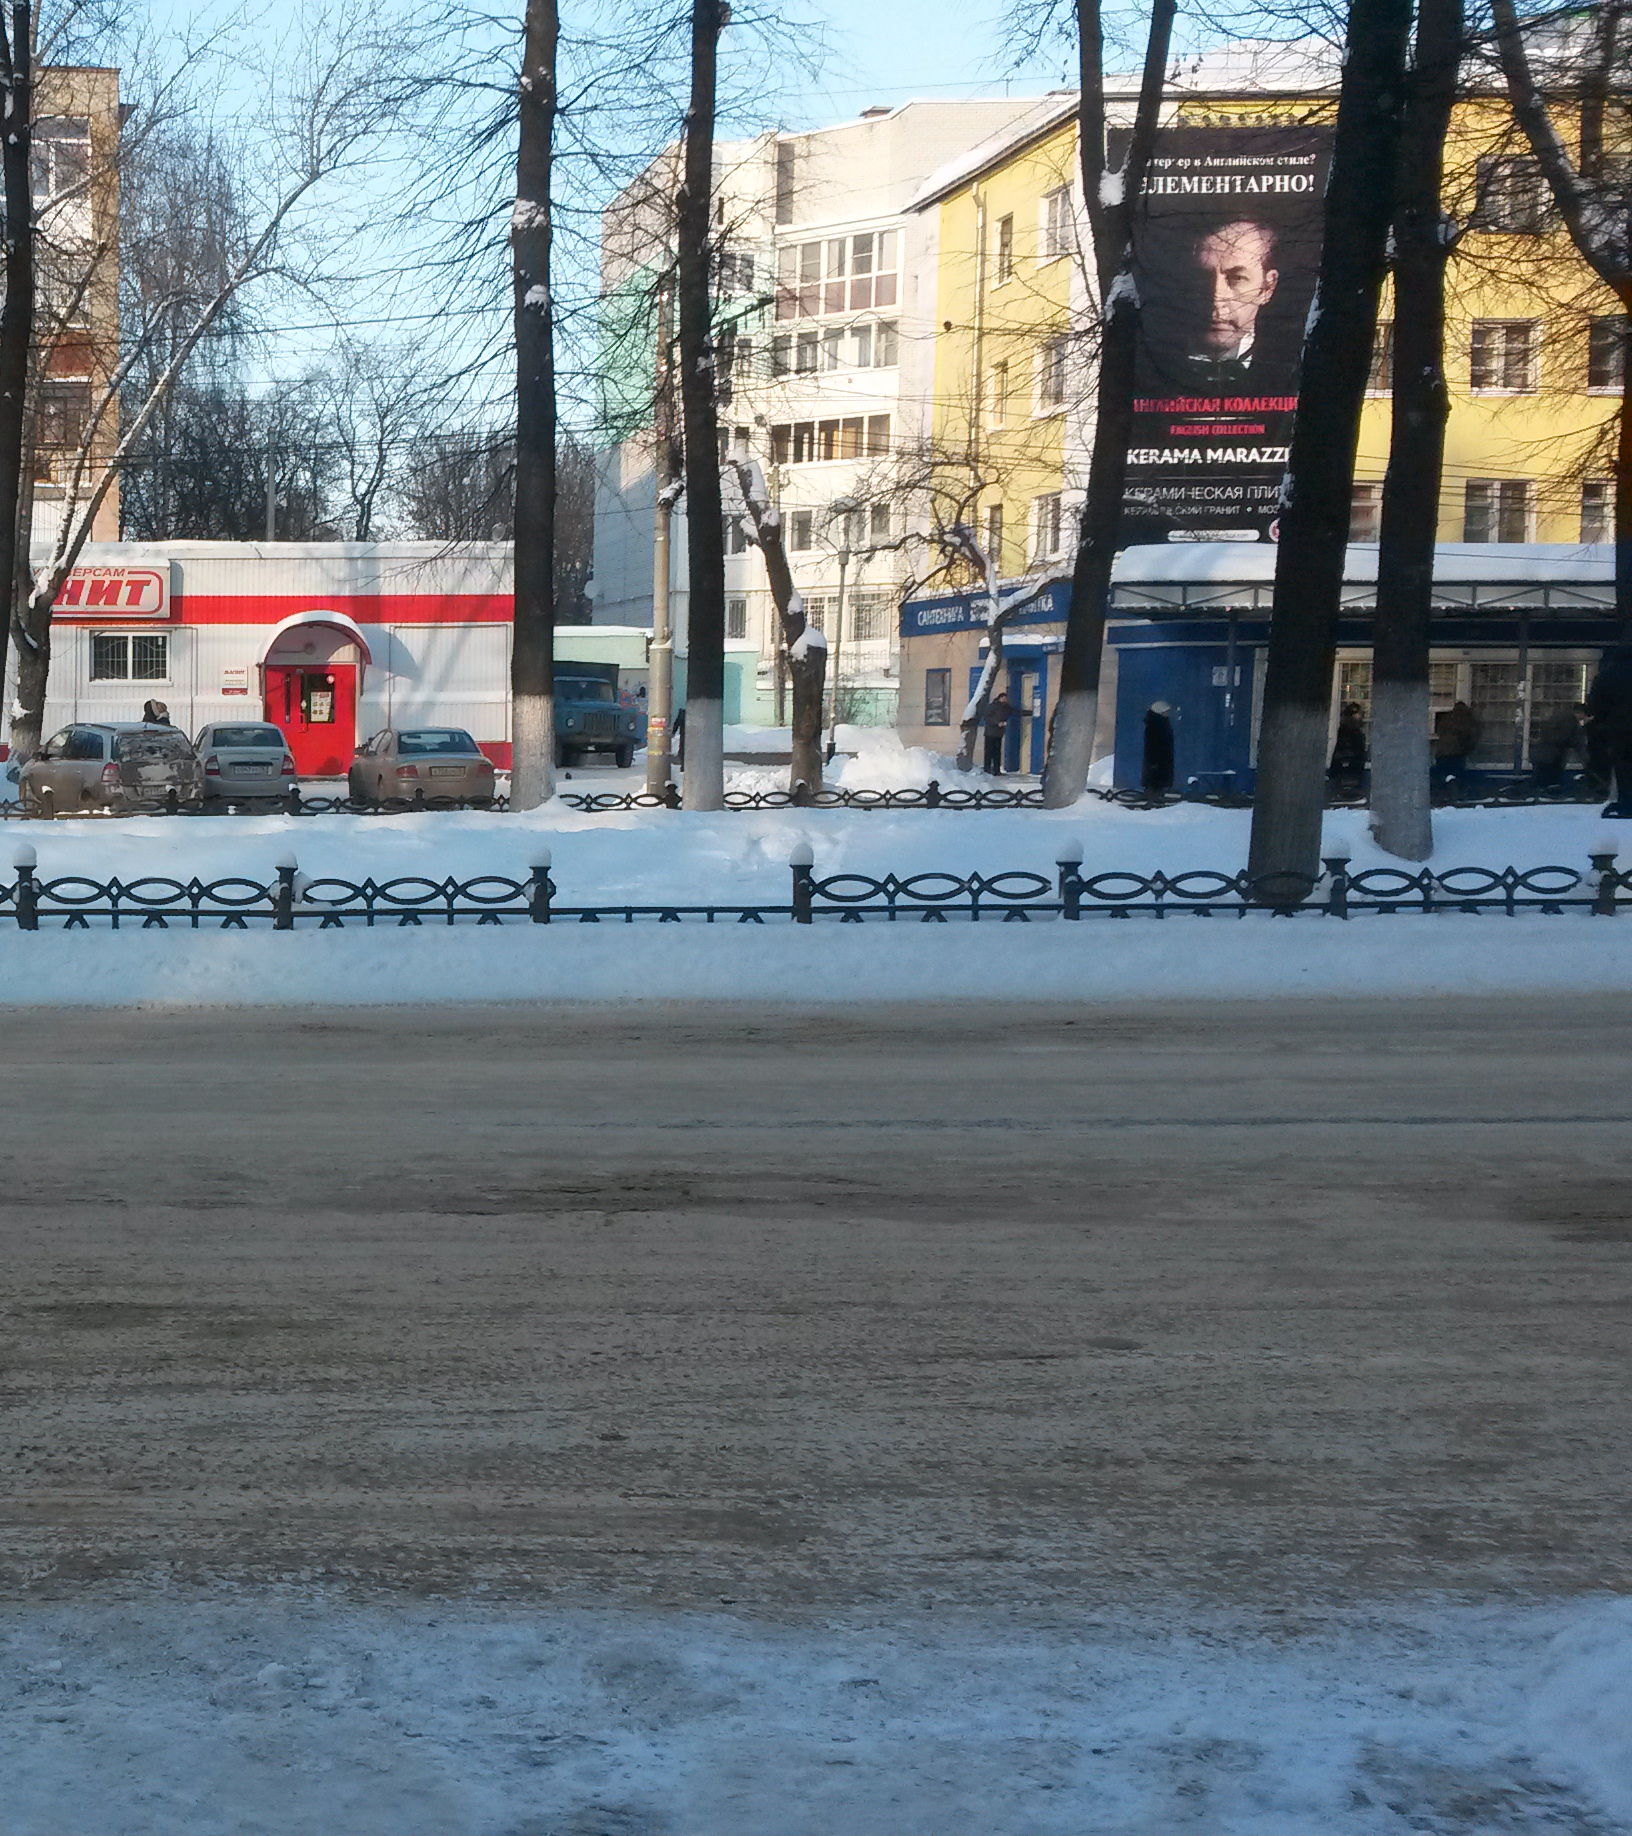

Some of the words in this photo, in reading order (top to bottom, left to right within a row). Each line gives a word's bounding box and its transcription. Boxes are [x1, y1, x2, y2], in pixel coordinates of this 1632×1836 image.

[1204, 155, 1274, 167] Английском
[1277, 153, 1317, 166] стиле?
[1170, 424, 1209, 436] ENGLISH
[1212, 423, 1266, 435] COLLECTION
[1127, 448, 1203, 465] KERAMA
[1207, 446, 1290, 464] MARAZZI
[917, 606, 965, 627] САНТЕХНИКА
